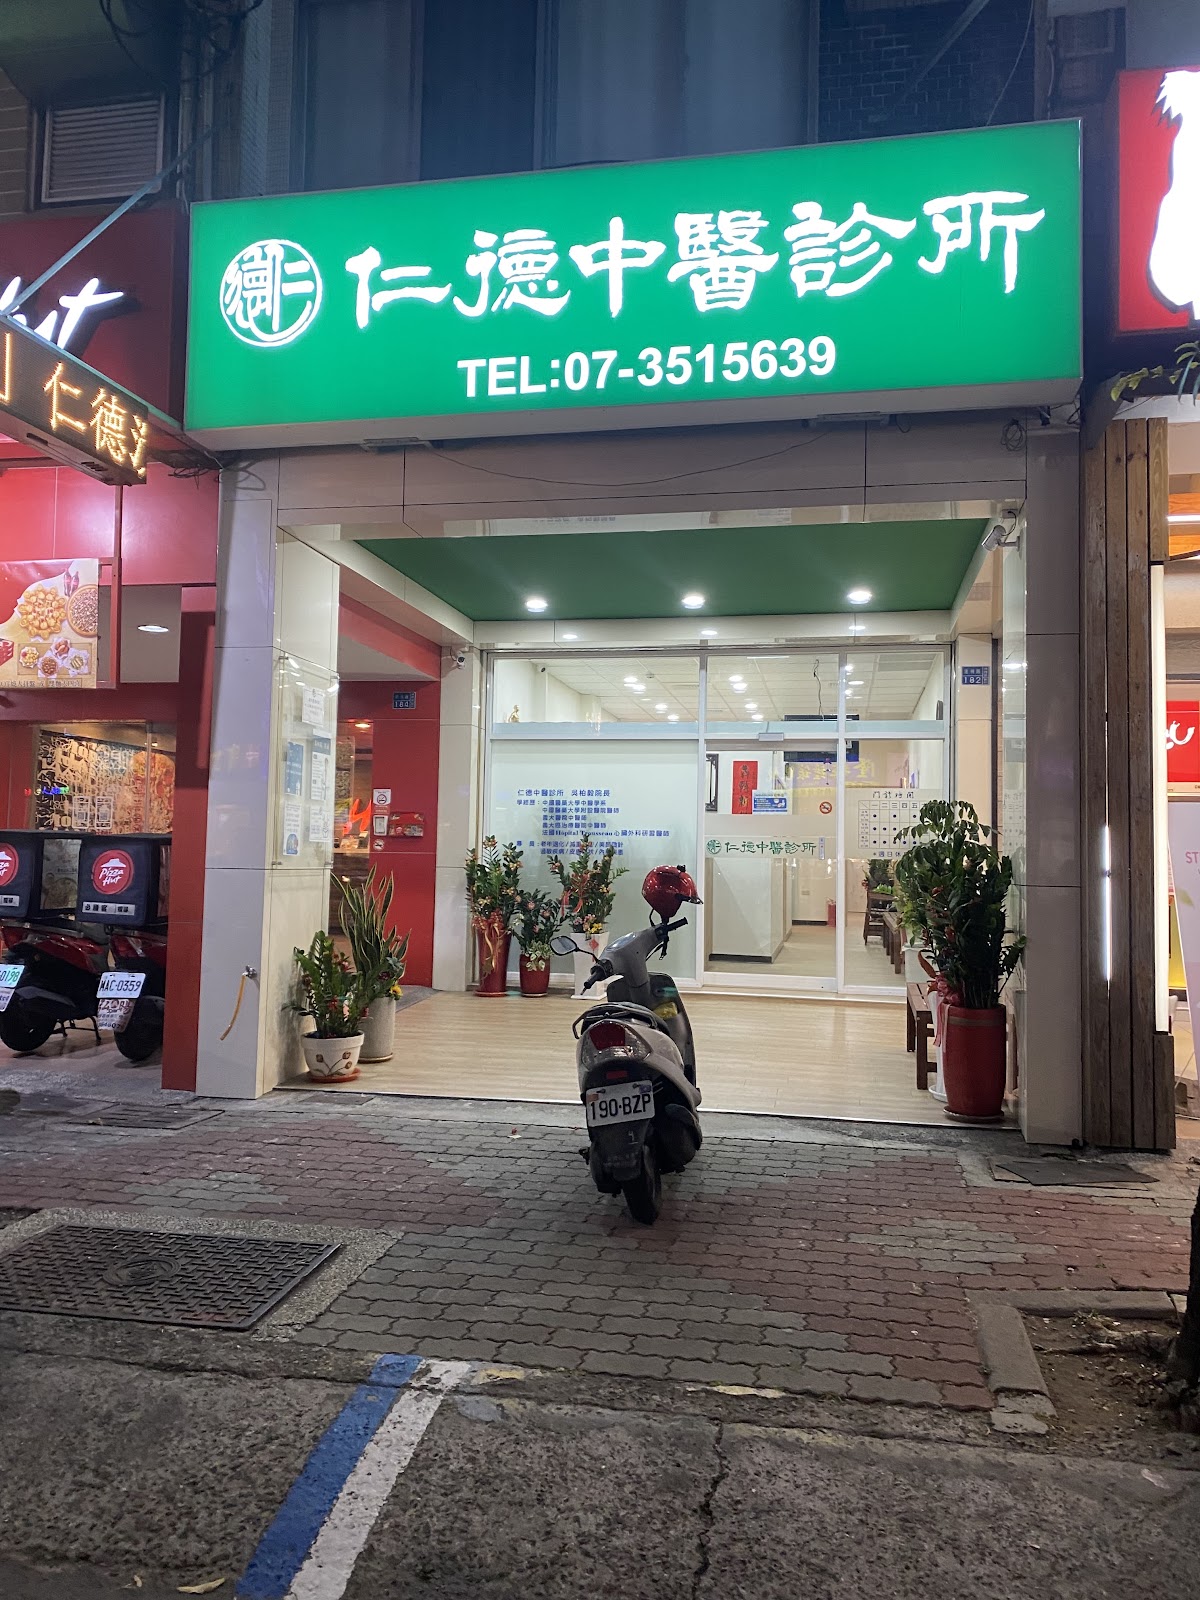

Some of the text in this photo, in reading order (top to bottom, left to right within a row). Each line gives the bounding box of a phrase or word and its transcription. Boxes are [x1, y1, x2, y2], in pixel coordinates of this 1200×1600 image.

[345, 191, 1045, 328] 仁德中醫診所
[457, 336, 836, 398] TEL:07-3515639
[964, 676, 981, 684] 182
[725, 841, 817, 855] 仁德中醫診所
[99, 867, 124, 880] Pizza
[103, 876, 122, 886] Hut
